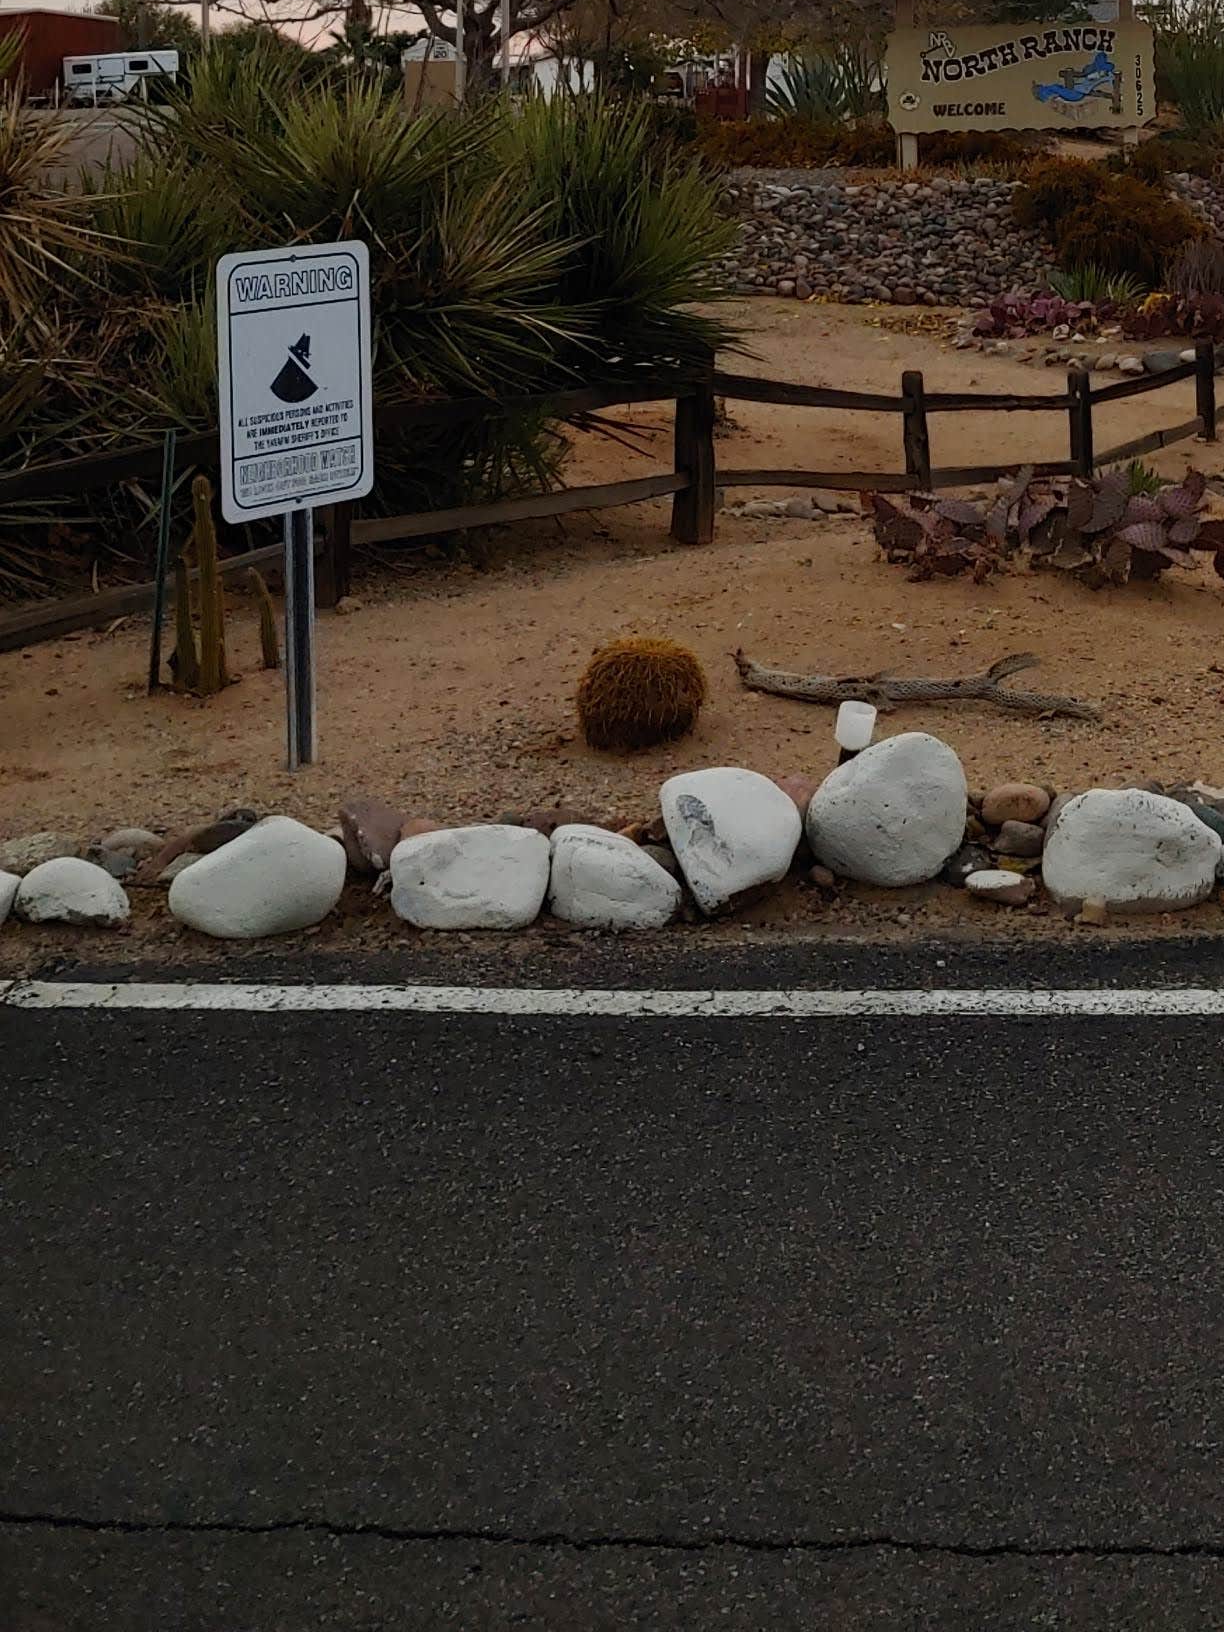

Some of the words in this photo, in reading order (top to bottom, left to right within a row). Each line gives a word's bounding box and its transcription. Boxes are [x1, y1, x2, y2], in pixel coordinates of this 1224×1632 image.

[920, 42, 1019, 84] NORTH
[1020, 28, 1116, 59] RANCH
[1135, 54, 1144, 116] 30625
[933, 102, 1006, 117] WELCOME
[236, 265, 353, 302] WARNING
[238, 418, 248, 428] ALL
[250, 411, 284, 426] SUSPICIOUS
[285, 407, 311, 420] PERSONS
[325, 399, 354, 413] ACTIVITIES
[260, 420, 309, 437] IMMEDIATELY
[311, 414, 339, 428] REPORTED
[340, 412, 348, 422] TO
[254, 440, 265, 451] THE
